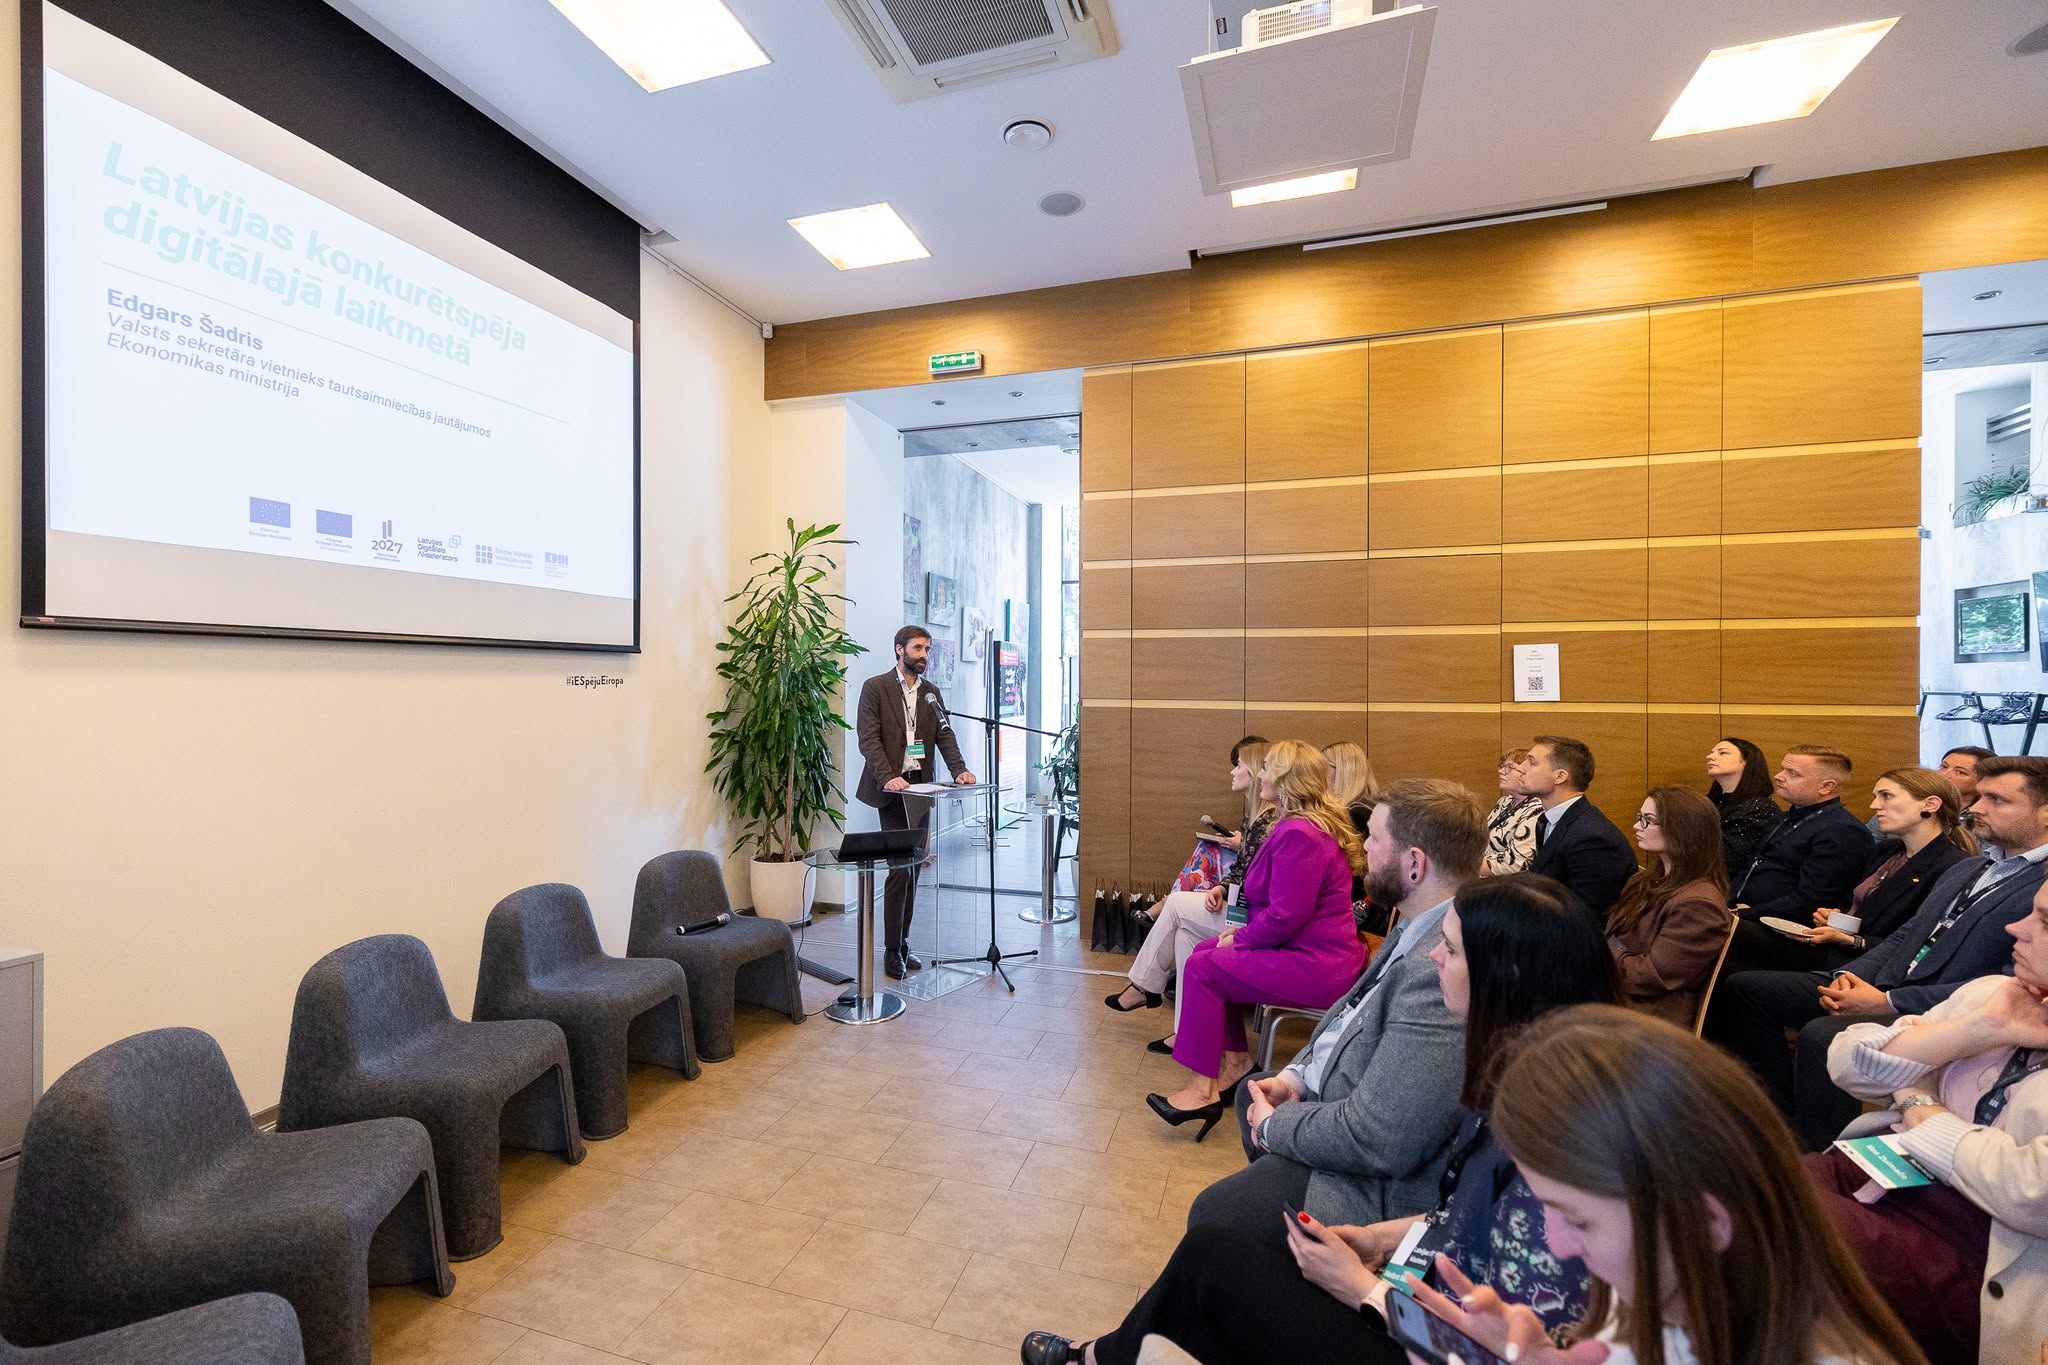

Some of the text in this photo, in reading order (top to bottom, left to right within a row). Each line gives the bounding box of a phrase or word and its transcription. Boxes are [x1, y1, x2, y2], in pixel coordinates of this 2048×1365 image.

[103, 140, 527, 352] Latvijas konkurētspēja
[103, 200, 472, 368] digitālajā laikmetā
[107, 288, 263, 351] Edgars Šadris
[107, 332, 300, 398] Ekonomikas ministrija
[108, 311, 492, 438] Valsts sekretāra vietnieks tautsaimniecības jautājumos
[371, 539, 404, 555] 2027
[566, 675, 624, 689] #iESpējuEiropa
